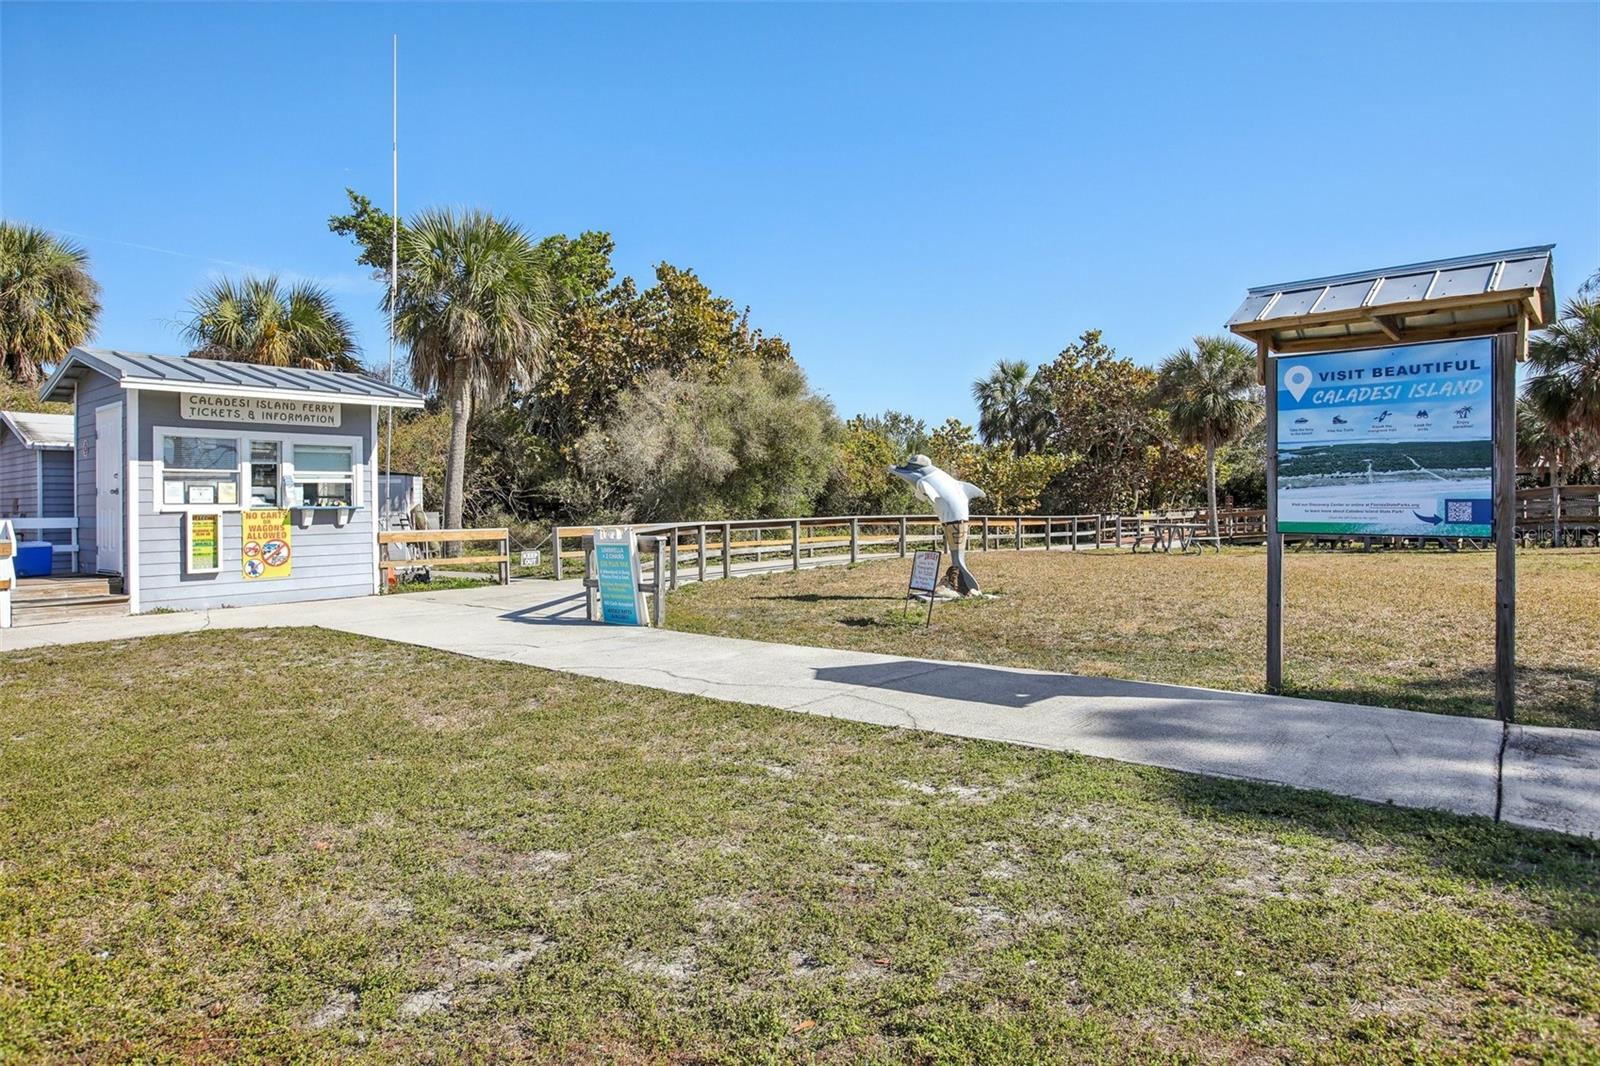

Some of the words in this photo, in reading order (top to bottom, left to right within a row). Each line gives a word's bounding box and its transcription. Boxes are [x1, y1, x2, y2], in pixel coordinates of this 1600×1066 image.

[1318, 368, 1364, 382] VISIT
[1372, 359, 1480, 378] BEAUTIFUL
[1312, 384, 1401, 404] CALADESI
[1408, 378, 1483, 398] ISLAND
[189, 395, 250, 408] CALADESI
[256, 399, 296, 411] ISLAND
[302, 402, 335, 413] FERRY
[189, 406, 241, 419] TICKETS
[248, 410, 255, 420] &
[262, 411, 335, 424] INFORMATION
[245, 511, 258, 520] NO
[260, 511, 288, 520] CARTS
[246, 532, 287, 540] ALLOWED
[248, 524, 285, 532] WAGONS
